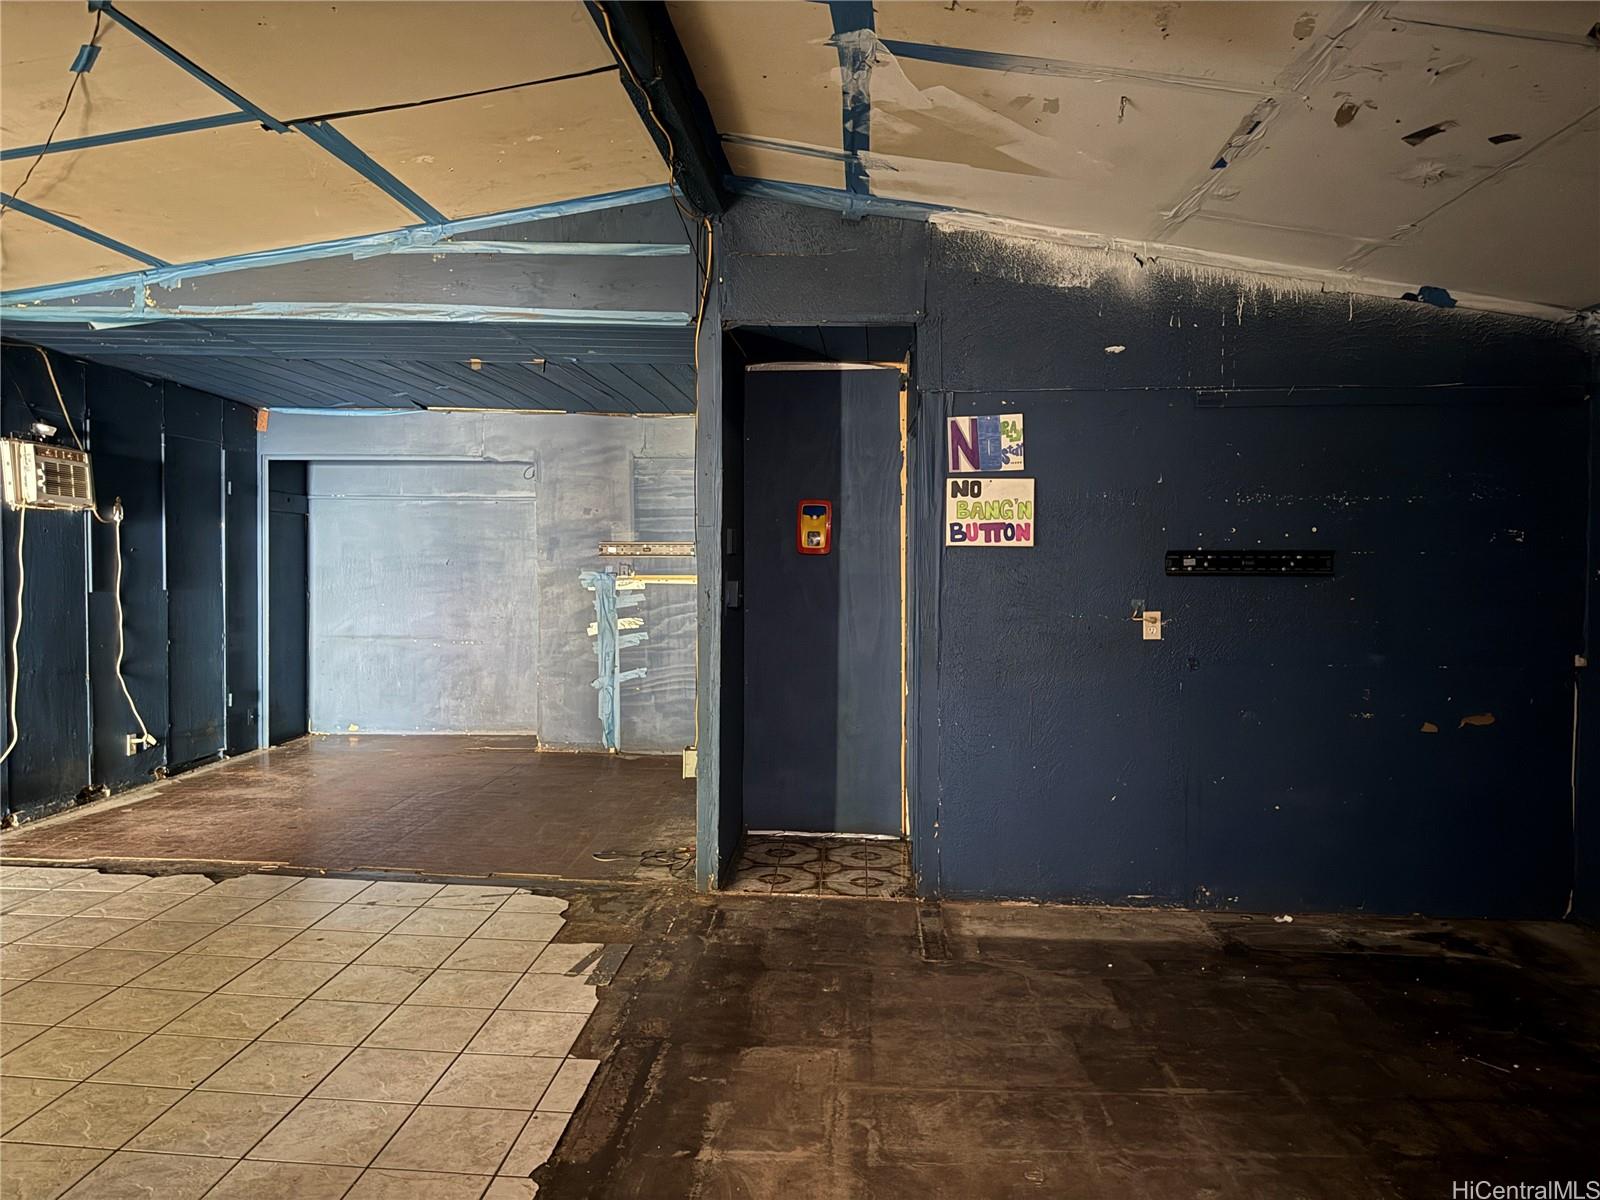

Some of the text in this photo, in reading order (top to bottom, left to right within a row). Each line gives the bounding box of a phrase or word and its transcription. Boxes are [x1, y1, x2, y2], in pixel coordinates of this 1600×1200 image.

[951, 480, 982, 498] NO
[956, 499, 1032, 520] BANG'N
[949, 522, 1031, 543] BUTTON
